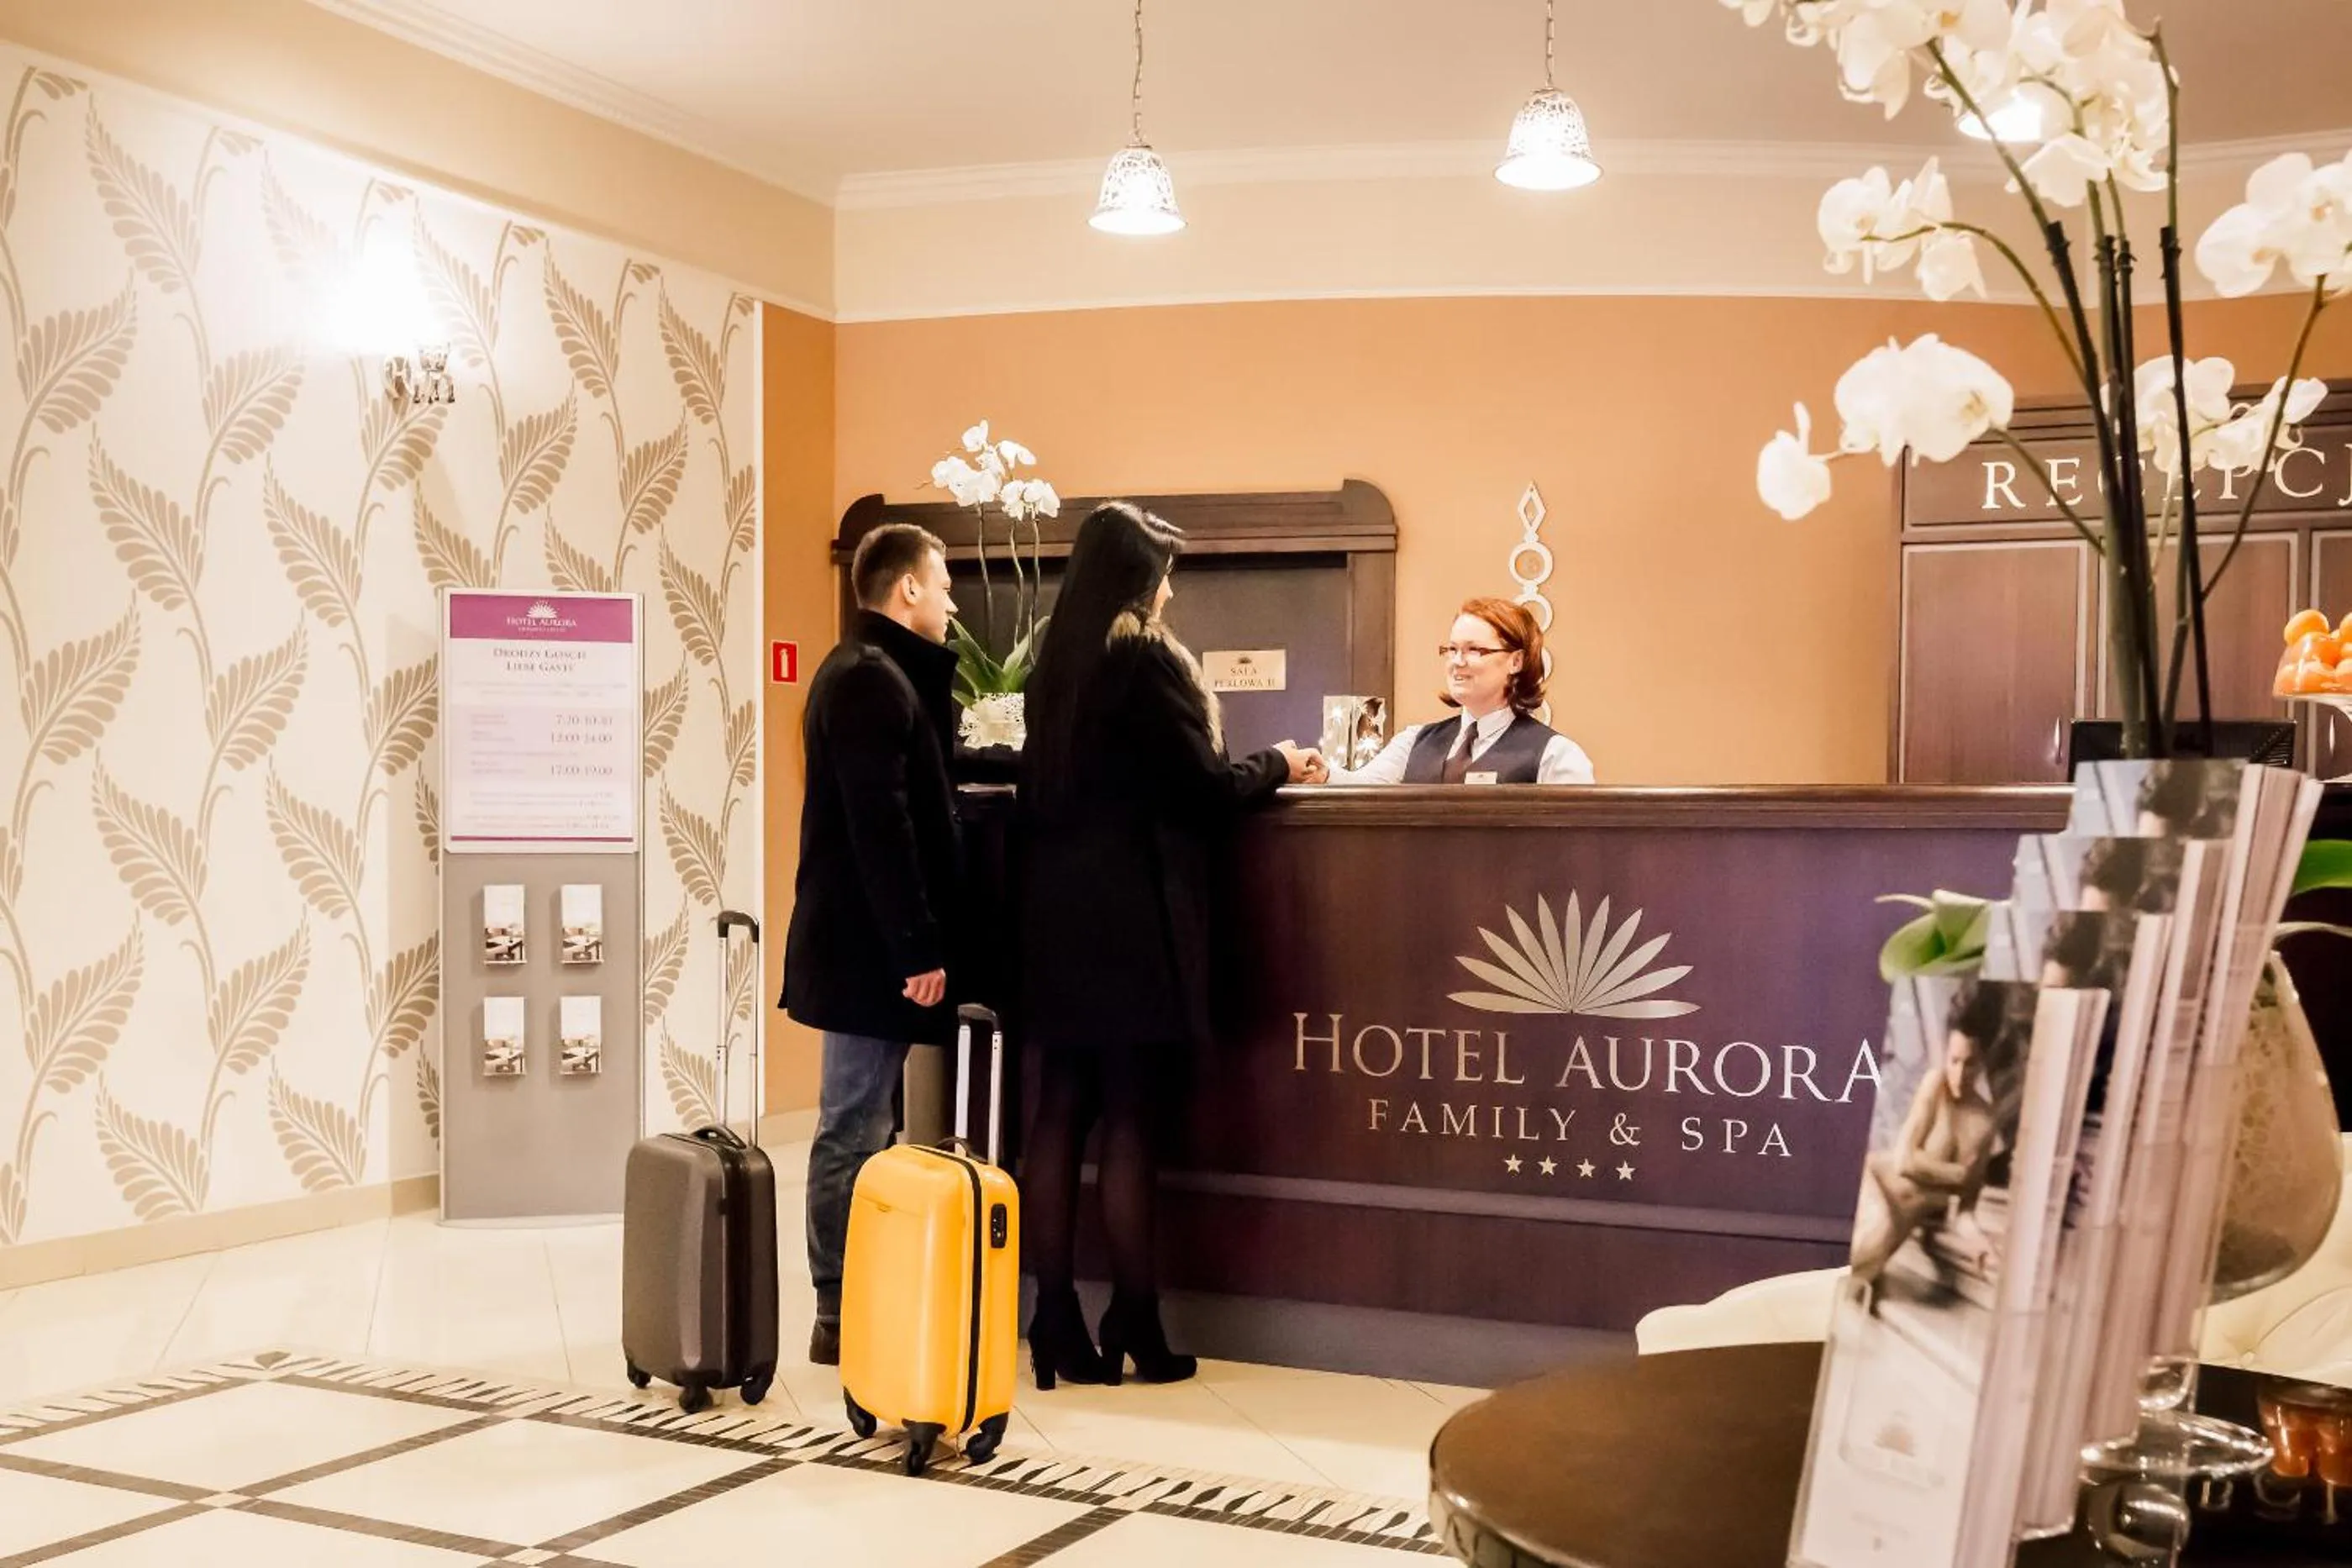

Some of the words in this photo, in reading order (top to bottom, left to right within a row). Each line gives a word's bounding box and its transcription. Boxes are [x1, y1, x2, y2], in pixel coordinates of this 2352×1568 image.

[1293, 1012, 1525, 1084] HOTEL
[1555, 1035, 1882, 1103] AURORA
[1368, 1098, 1576, 1141] FAMILY
[1609, 1112, 1641, 1146] &
[1681, 1117, 1792, 1157] SPA
